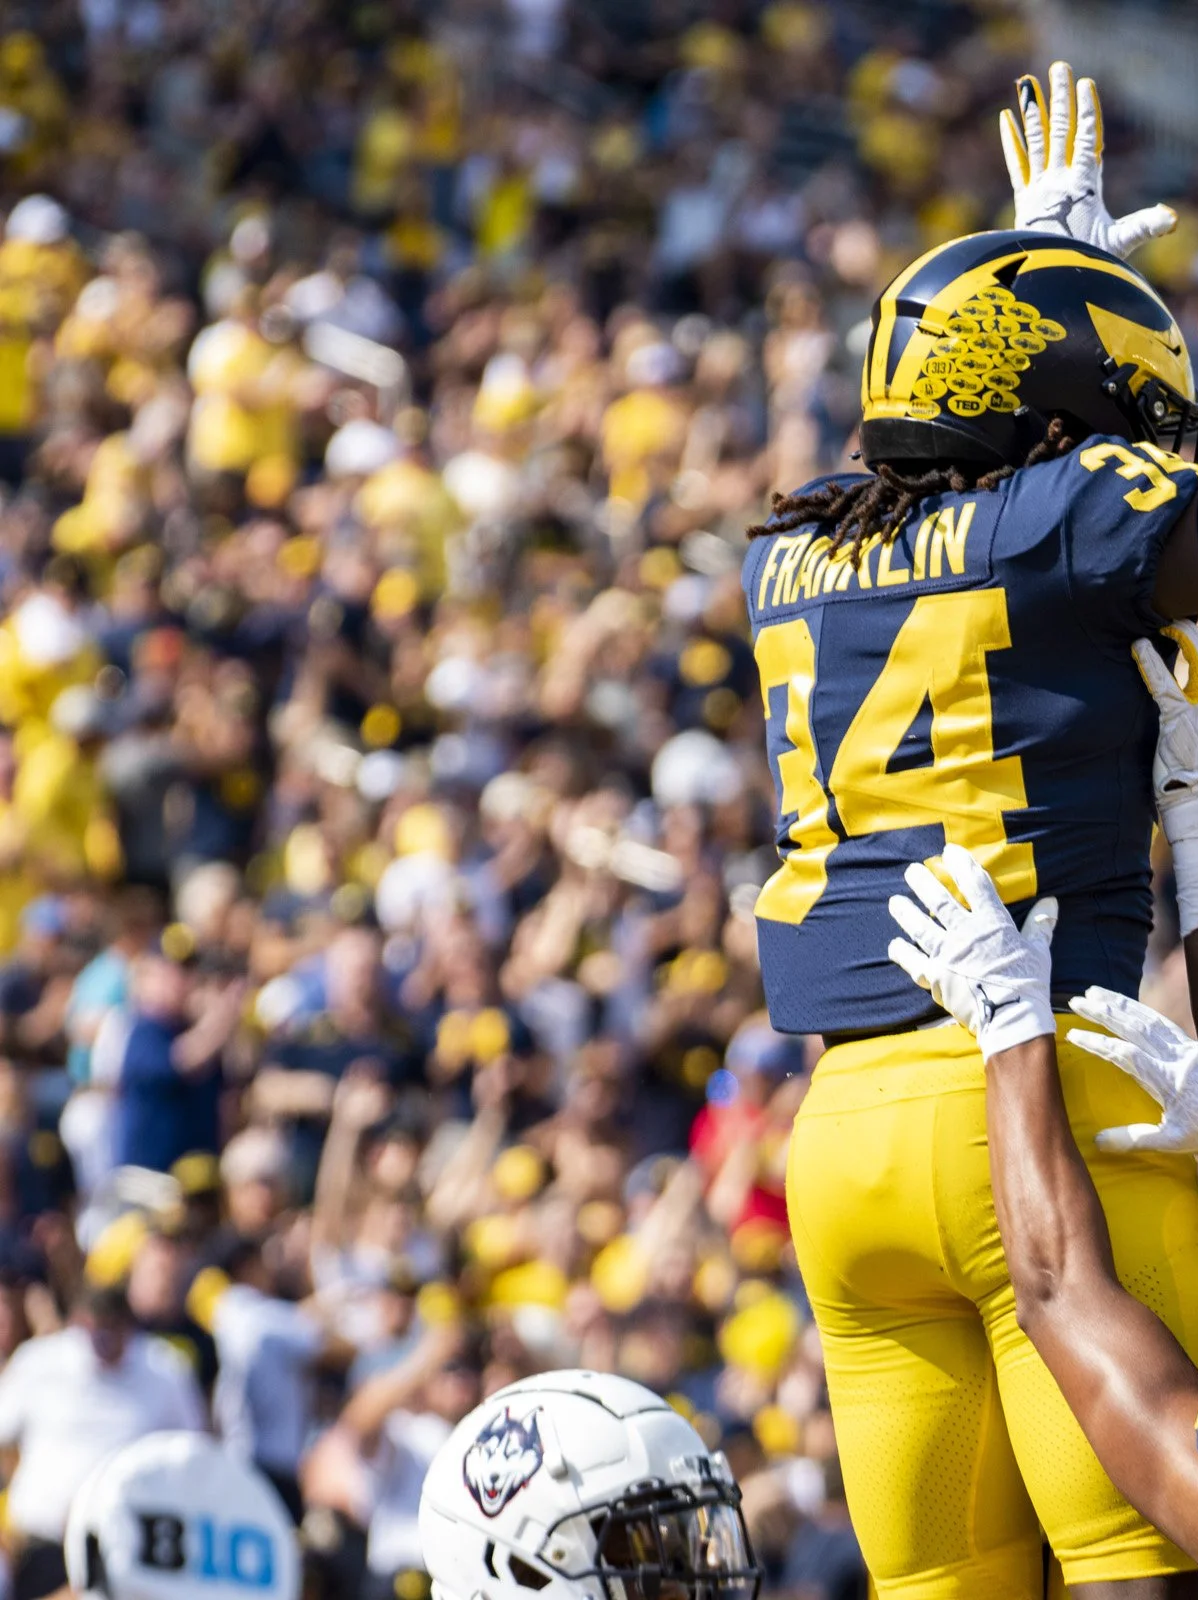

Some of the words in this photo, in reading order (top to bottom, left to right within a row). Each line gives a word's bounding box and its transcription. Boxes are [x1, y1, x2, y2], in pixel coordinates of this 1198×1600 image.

[954, 399, 980, 411] TED
[758, 502, 977, 610] FRANKLIN
[753, 588, 1037, 924] 34
